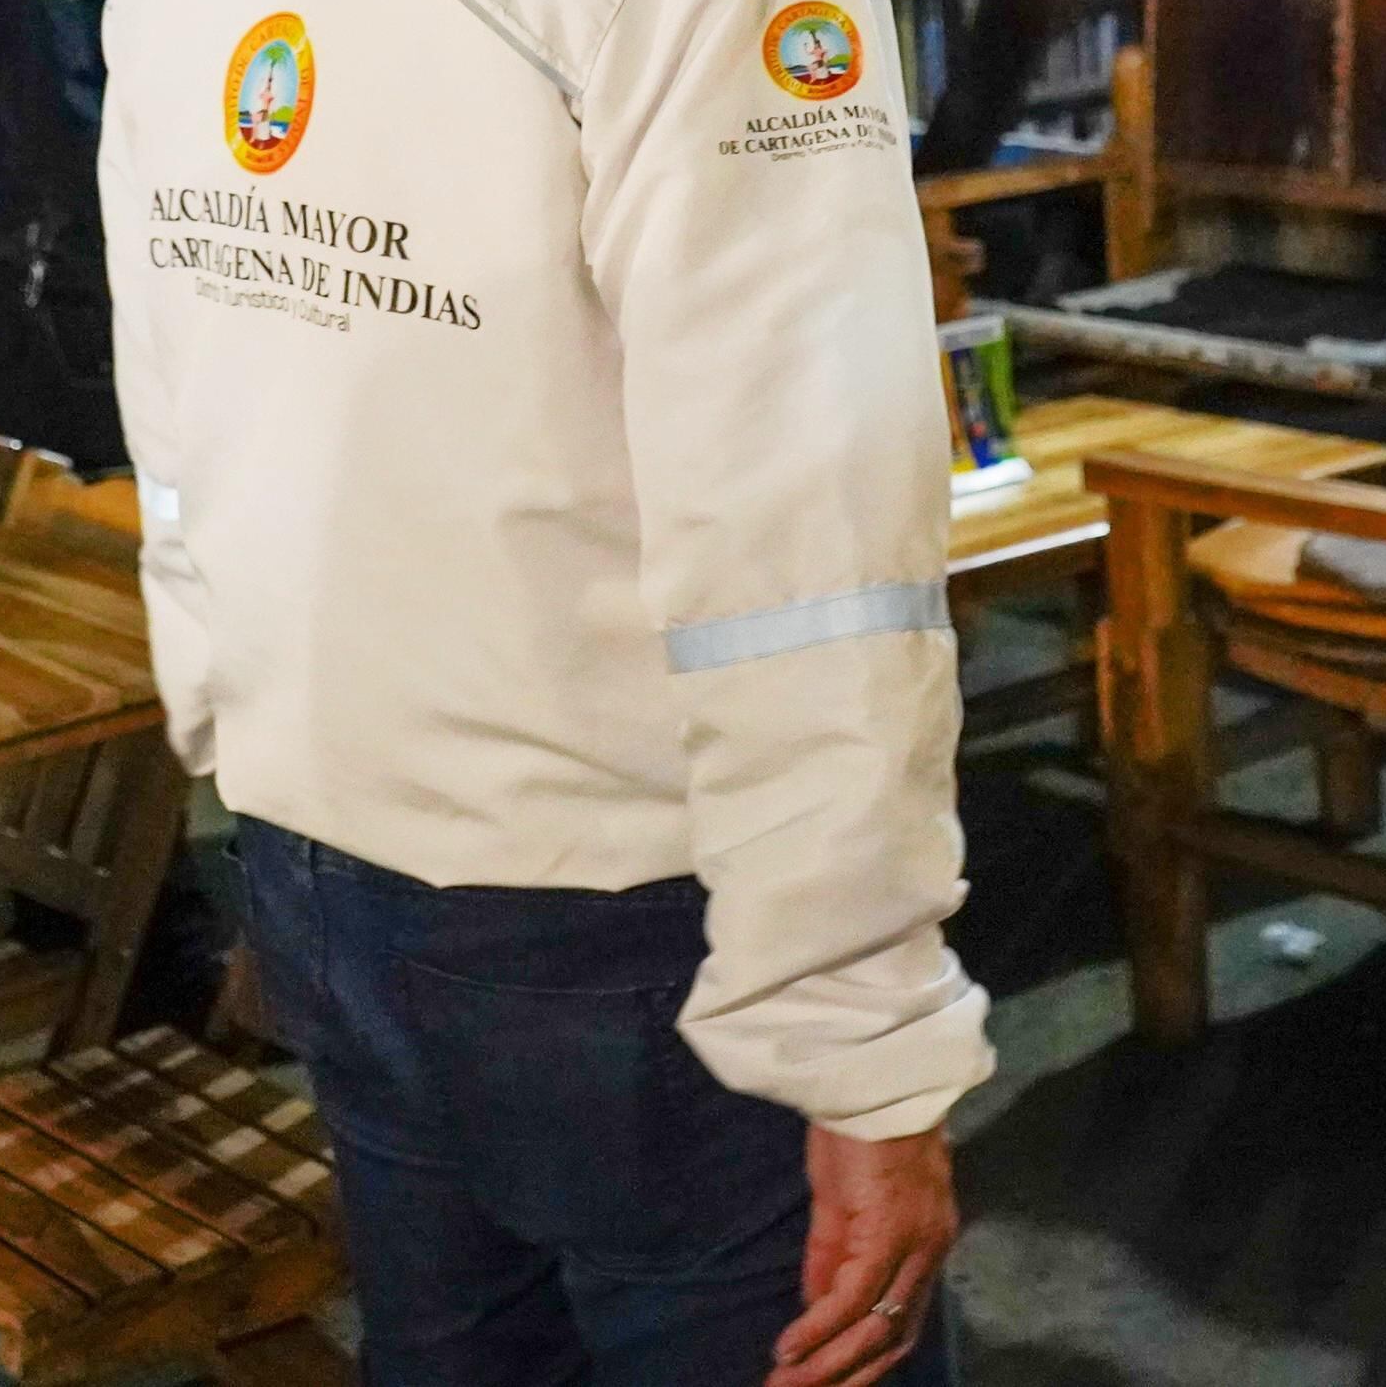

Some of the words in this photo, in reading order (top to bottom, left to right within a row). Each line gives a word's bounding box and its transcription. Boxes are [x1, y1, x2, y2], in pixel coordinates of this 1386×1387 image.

[718, 140, 741, 156] DE
[744, 124, 853, 155] CARTAGENA
[745, 104, 838, 134] ALCALDÍA
[149, 185, 270, 234] ALCALDÍA
[281, 200, 411, 261] MAYOR
[150, 237, 295, 287] CARTAGENA
[300, 256, 332, 299] DE
[340, 268, 482, 331] INDIAS
